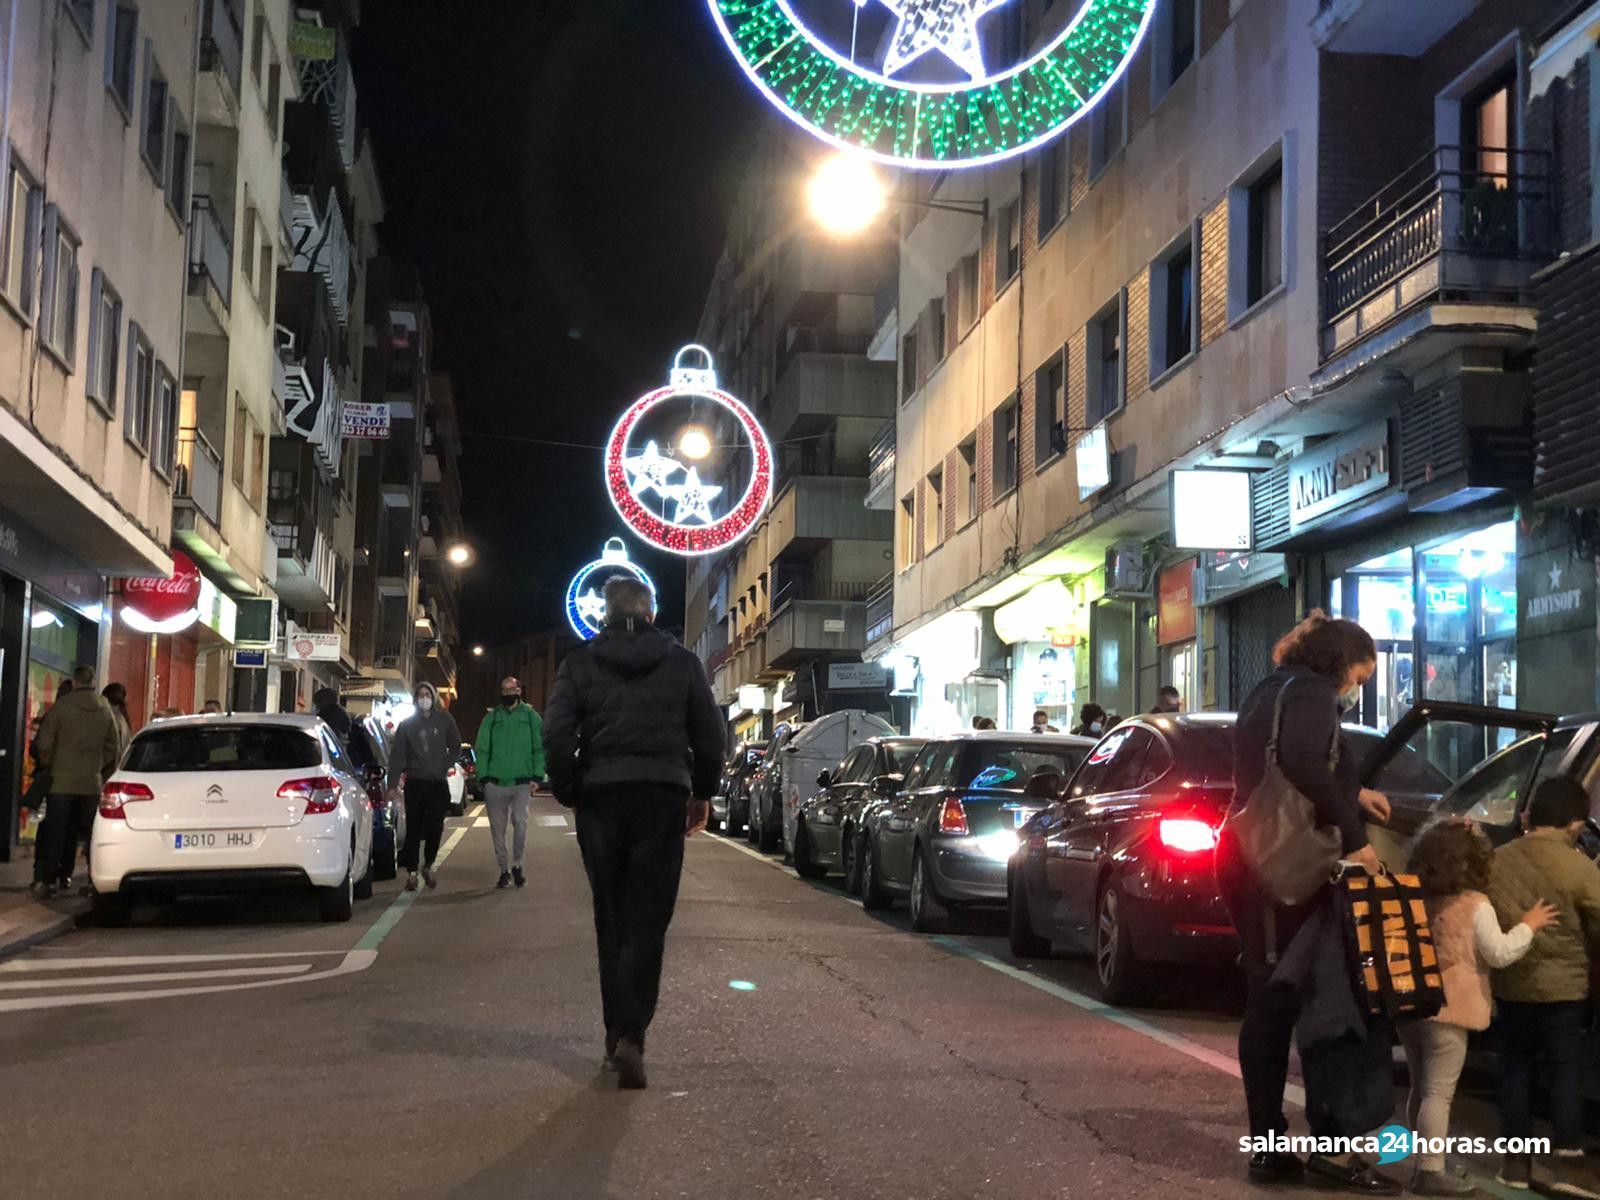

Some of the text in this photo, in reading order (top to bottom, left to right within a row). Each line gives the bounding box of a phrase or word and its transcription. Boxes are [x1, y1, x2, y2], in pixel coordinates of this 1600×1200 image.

[344, 416, 387, 426] VENDE
[1526, 588, 1581, 617] ARMYSOFT
[183, 832, 254, 848] 3010 HHJ
